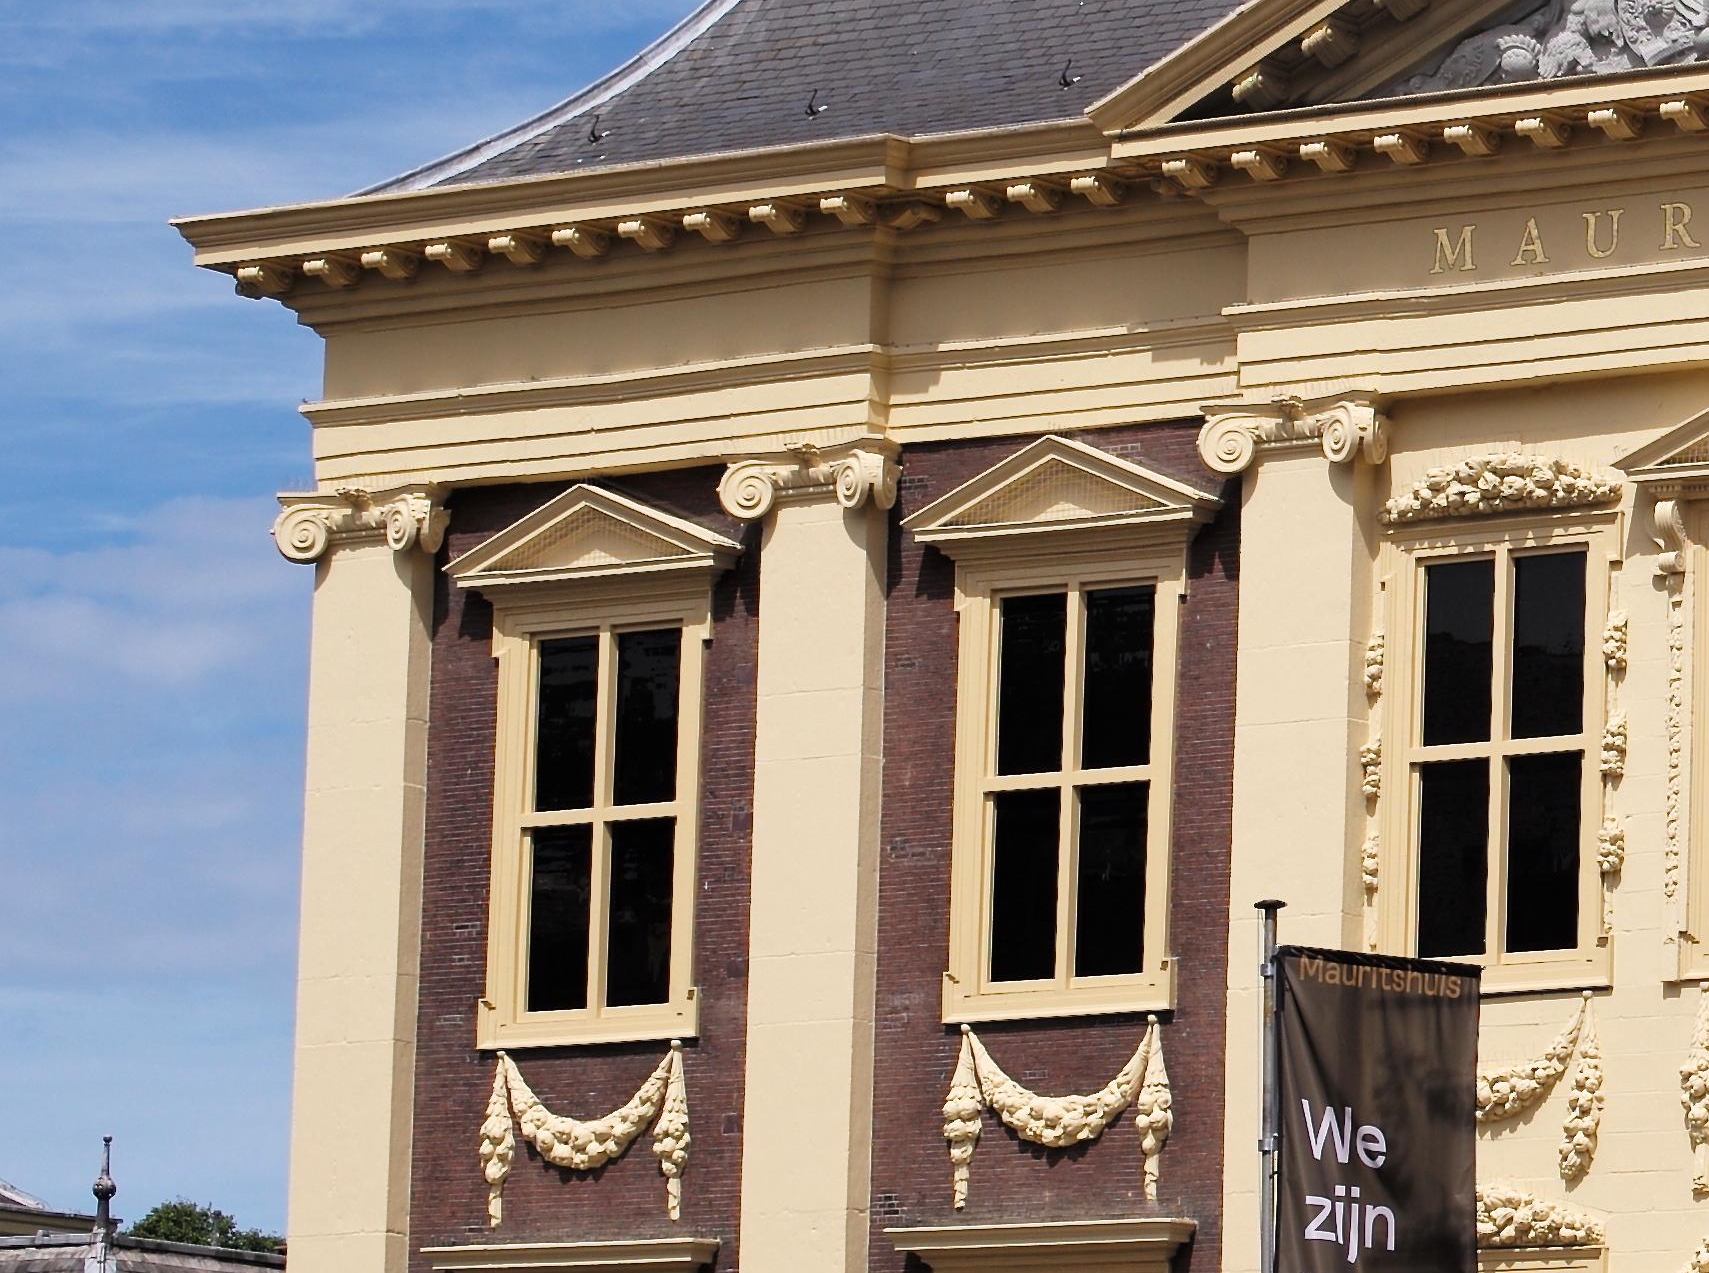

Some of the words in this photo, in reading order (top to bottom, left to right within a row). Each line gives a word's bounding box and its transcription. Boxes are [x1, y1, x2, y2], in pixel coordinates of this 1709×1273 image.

[1299, 955, 1462, 999] Mauritshuis
[1301, 1098, 1388, 1169] We
[1303, 1185, 1396, 1264] zijn
